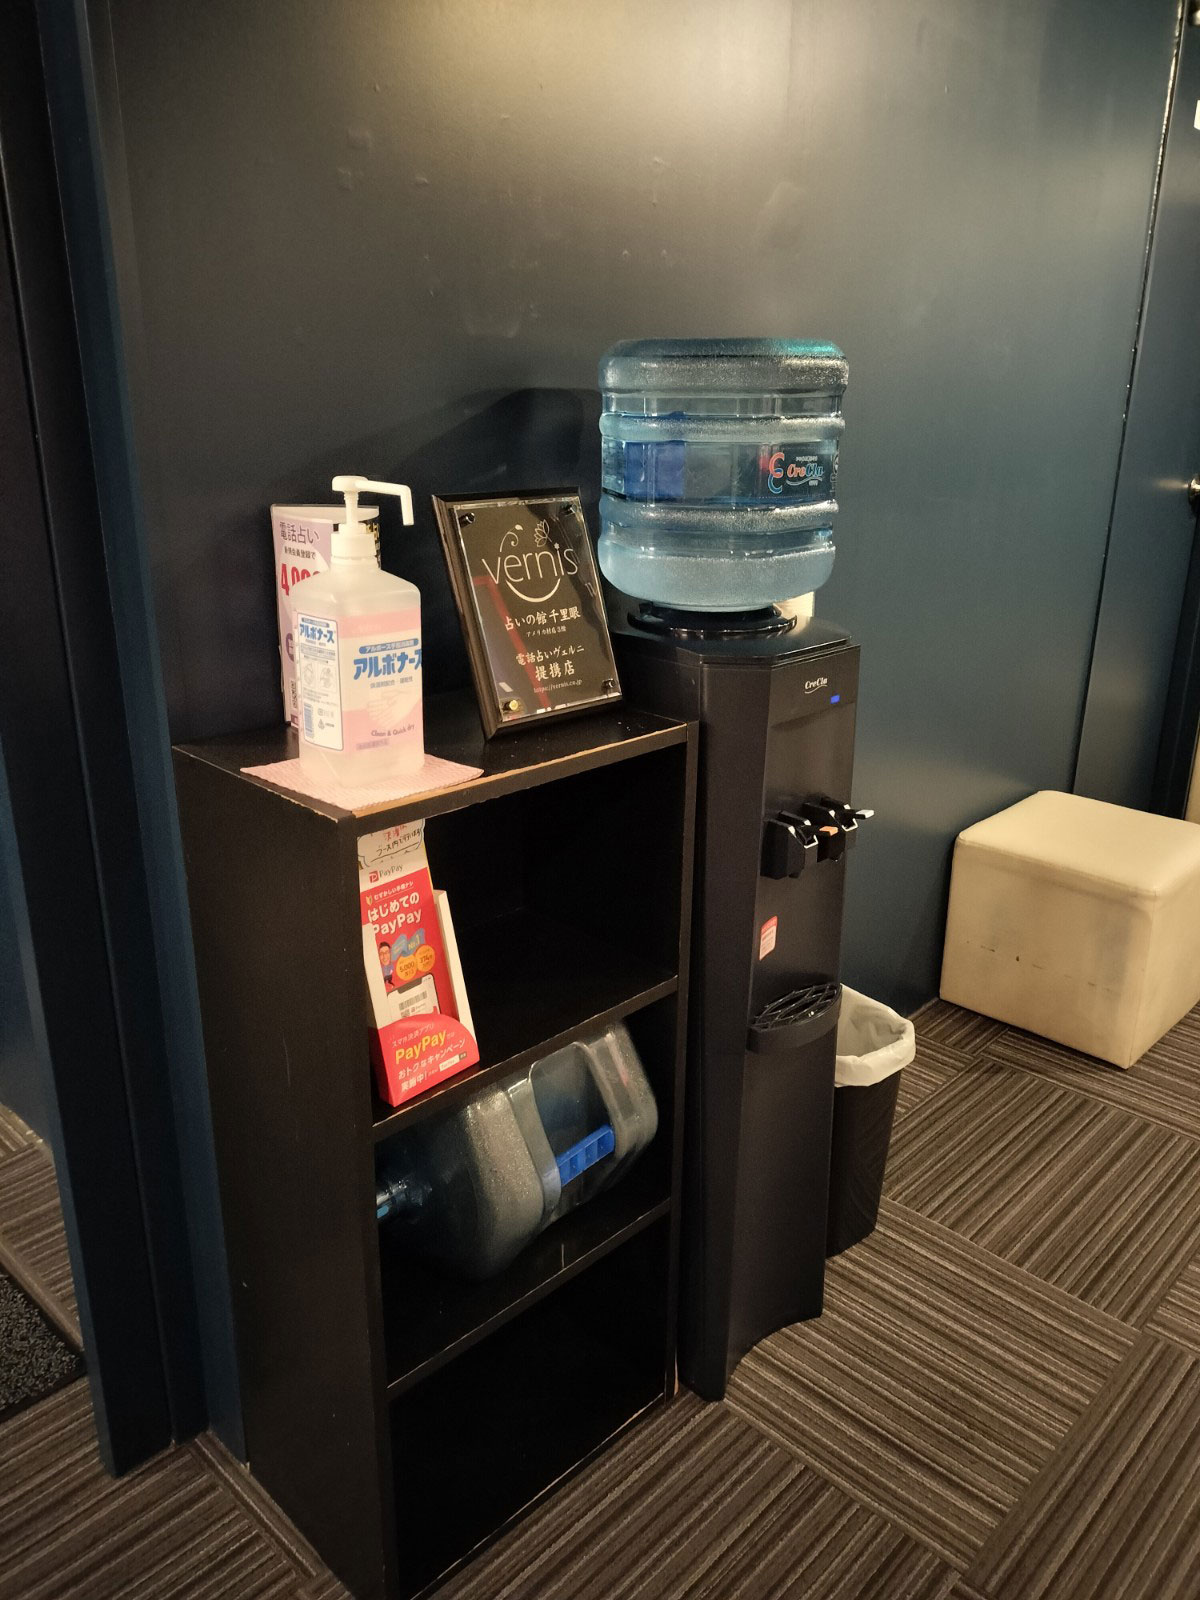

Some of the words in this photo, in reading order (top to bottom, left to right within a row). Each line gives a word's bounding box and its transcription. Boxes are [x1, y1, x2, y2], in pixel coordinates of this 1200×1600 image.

[280, 521, 320, 545] 電話占い
[482, 543, 578, 584] vernis
[300, 623, 335, 643] アルボナース
[516, 645, 585, 666] 電話占いヴェルニ
[535, 660, 576, 681] 提携店
[804, 677, 828, 689] CreCla
[379, 864, 403, 878] PayPay
[368, 892, 420, 923] はじめての
[372, 909, 422, 935] PayPay
[396, 1029, 446, 1065] PayPay
[398, 1038, 466, 1080] おトクなキャンペーン
